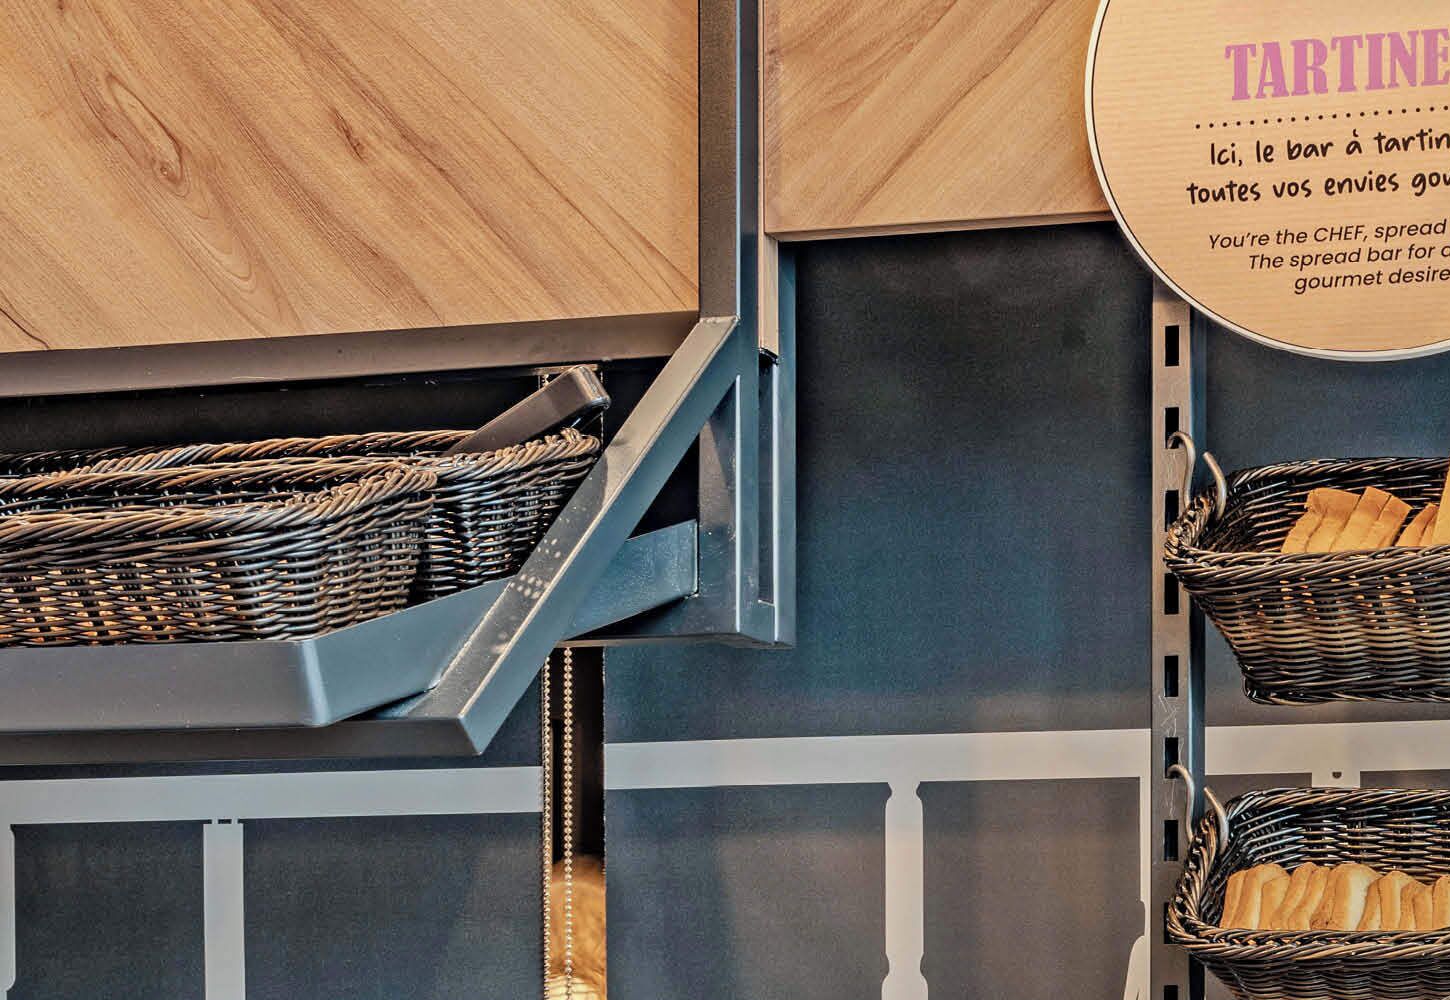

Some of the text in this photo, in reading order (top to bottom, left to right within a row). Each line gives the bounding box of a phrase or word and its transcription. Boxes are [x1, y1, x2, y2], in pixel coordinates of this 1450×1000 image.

[1210, 143, 1243, 167] Ici,
[1255, 140, 1275, 163] le
[1286, 139, 1334, 161] bar
[1345, 128, 1363, 155] à
[1186, 180, 1262, 205] toutes
[1272, 178, 1313, 198] vos
[1324, 170, 1400, 196] envies
[1275, 229, 1308, 245] the
[1313, 224, 1368, 243] CHEF,
[1374, 218, 1447, 243] spread
[1249, 254, 1285, 270] The
[1289, 247, 1362, 272] spread
[1366, 247, 1402, 262] bar
[1407, 243, 1437, 260] for
[1294, 269, 1383, 295] gourmet
